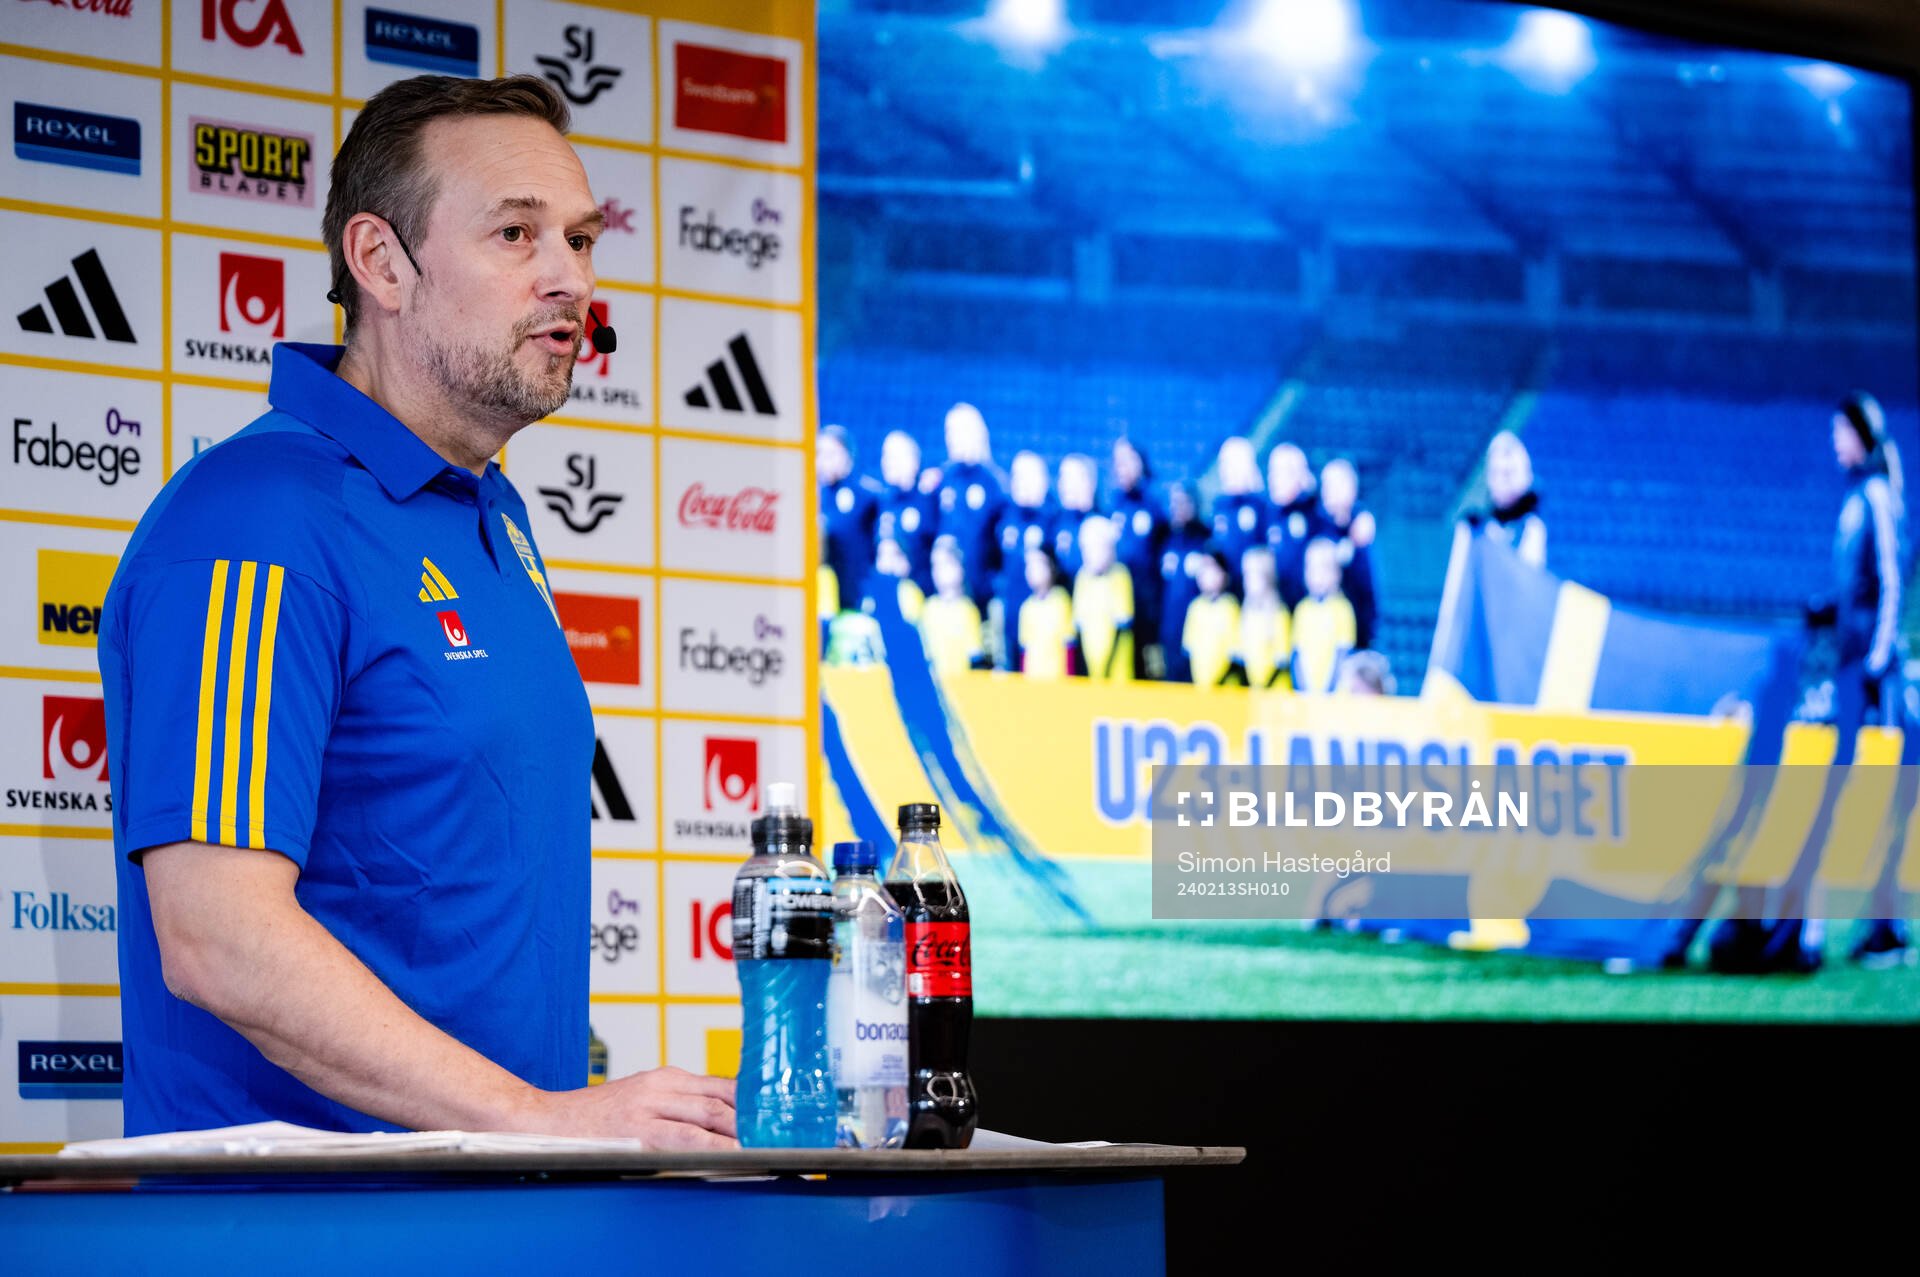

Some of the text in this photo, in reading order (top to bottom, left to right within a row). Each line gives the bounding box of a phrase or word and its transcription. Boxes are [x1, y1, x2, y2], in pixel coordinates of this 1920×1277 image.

[201, 0, 304, 56] ICA
[563, 25, 594, 63] SJ
[195, 124, 310, 184] SPORT
[201, 173, 306, 200] BLADET
[678, 206, 782, 269] Fabege
[185, 338, 271, 365] SVENSKA
[13, 418, 141, 485] Fabege
[565, 454, 595, 490] SJ
[444, 649, 489, 660] SVENSKA SPEL
[679, 627, 783, 685] Fabege
[6, 789, 98, 811] SVENSKA
[11, 891, 116, 932] Folksa
